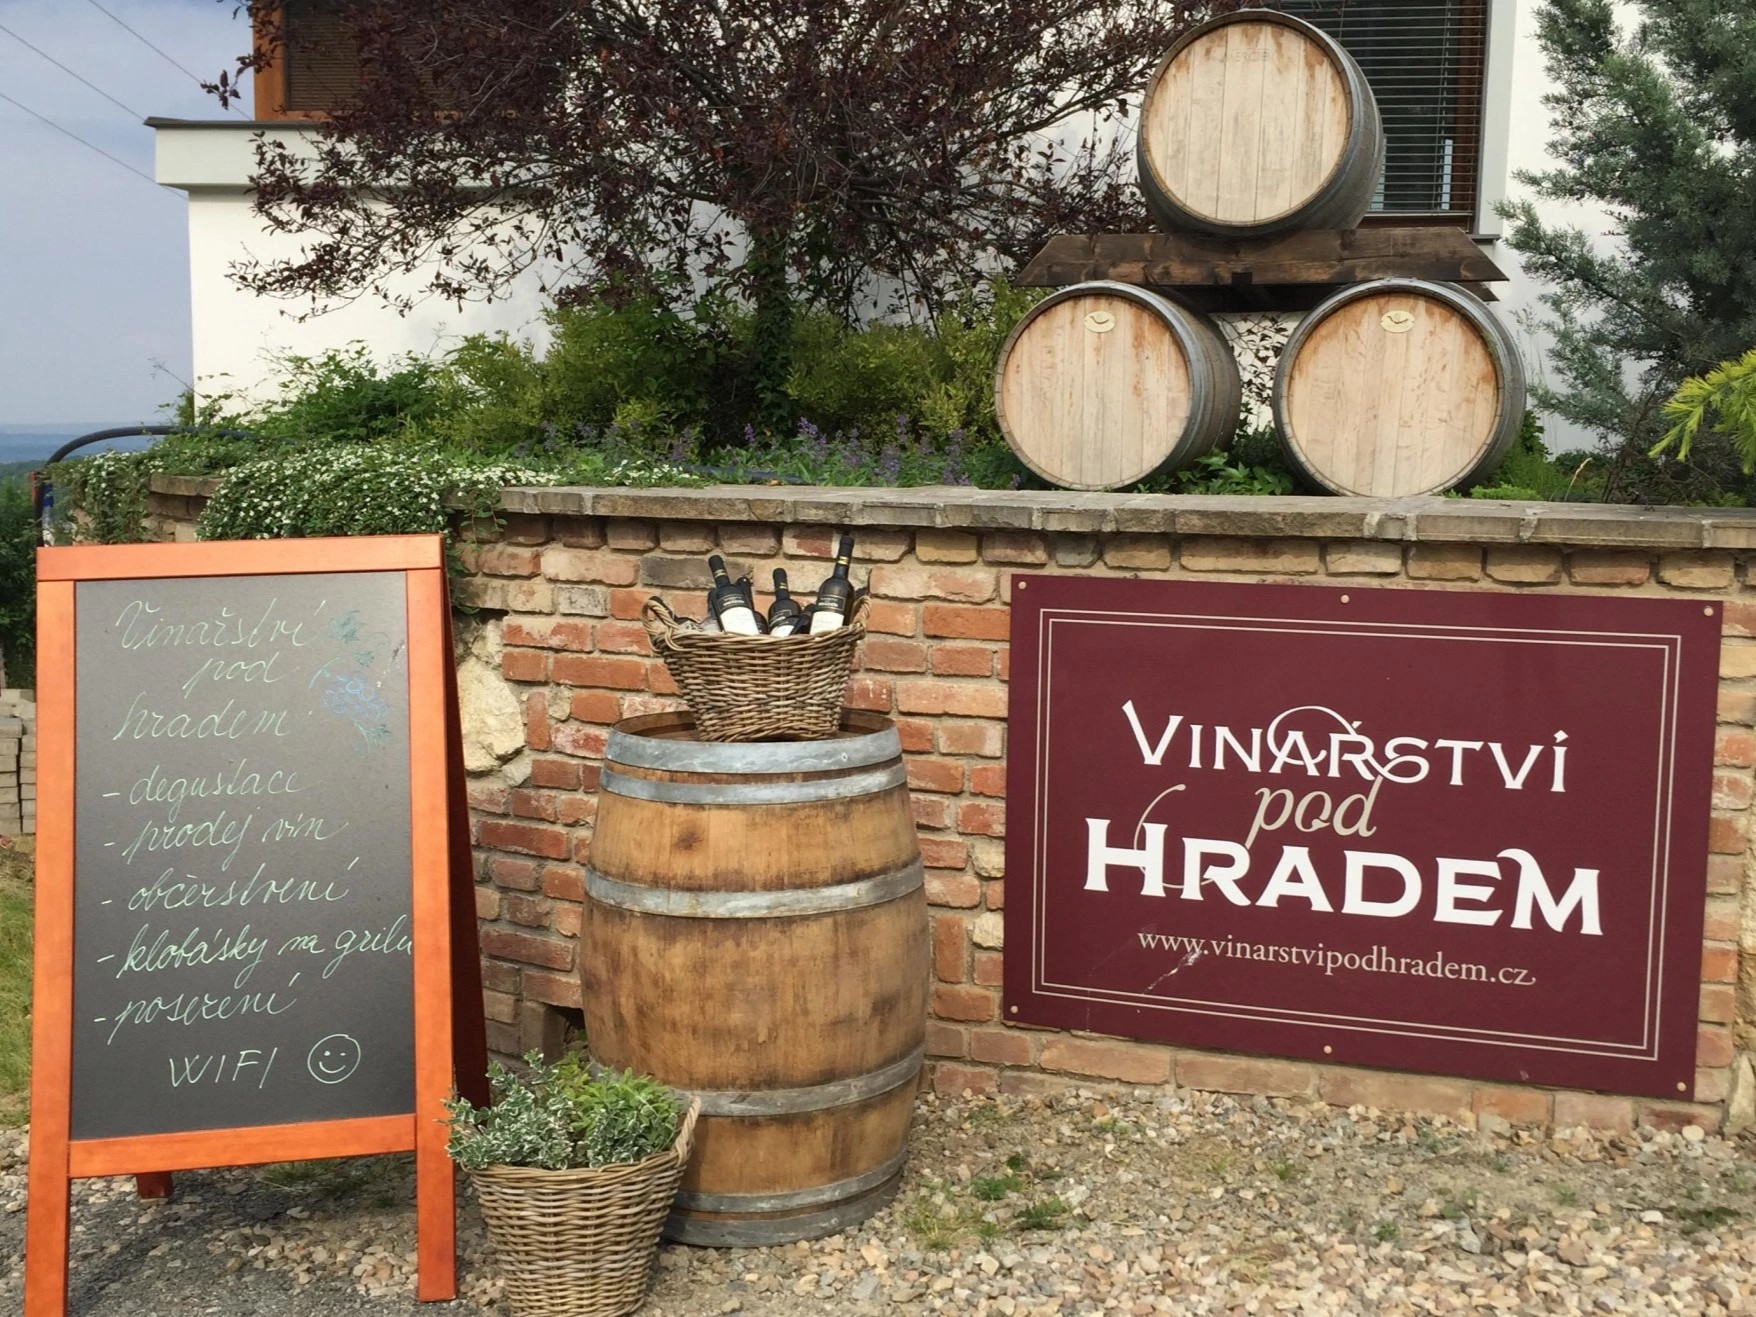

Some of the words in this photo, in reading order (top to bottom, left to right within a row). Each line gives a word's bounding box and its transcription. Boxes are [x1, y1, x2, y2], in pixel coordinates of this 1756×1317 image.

[182, 650, 286, 699] pod
[112, 690, 292, 741] hradem
[129, 757, 312, 823] degustace
[1244, 774, 1384, 850] pod
[121, 810, 253, 872] prodej
[1083, 816, 1604, 936] HRADEM
[115, 922, 268, 990] klobásky
[277, 934, 326, 956] na
[322, 913, 413, 980] grilu
[1136, 931, 1538, 987] www.vinarstvipodhradem.cz
[168, 1046, 279, 1090] WIFI
